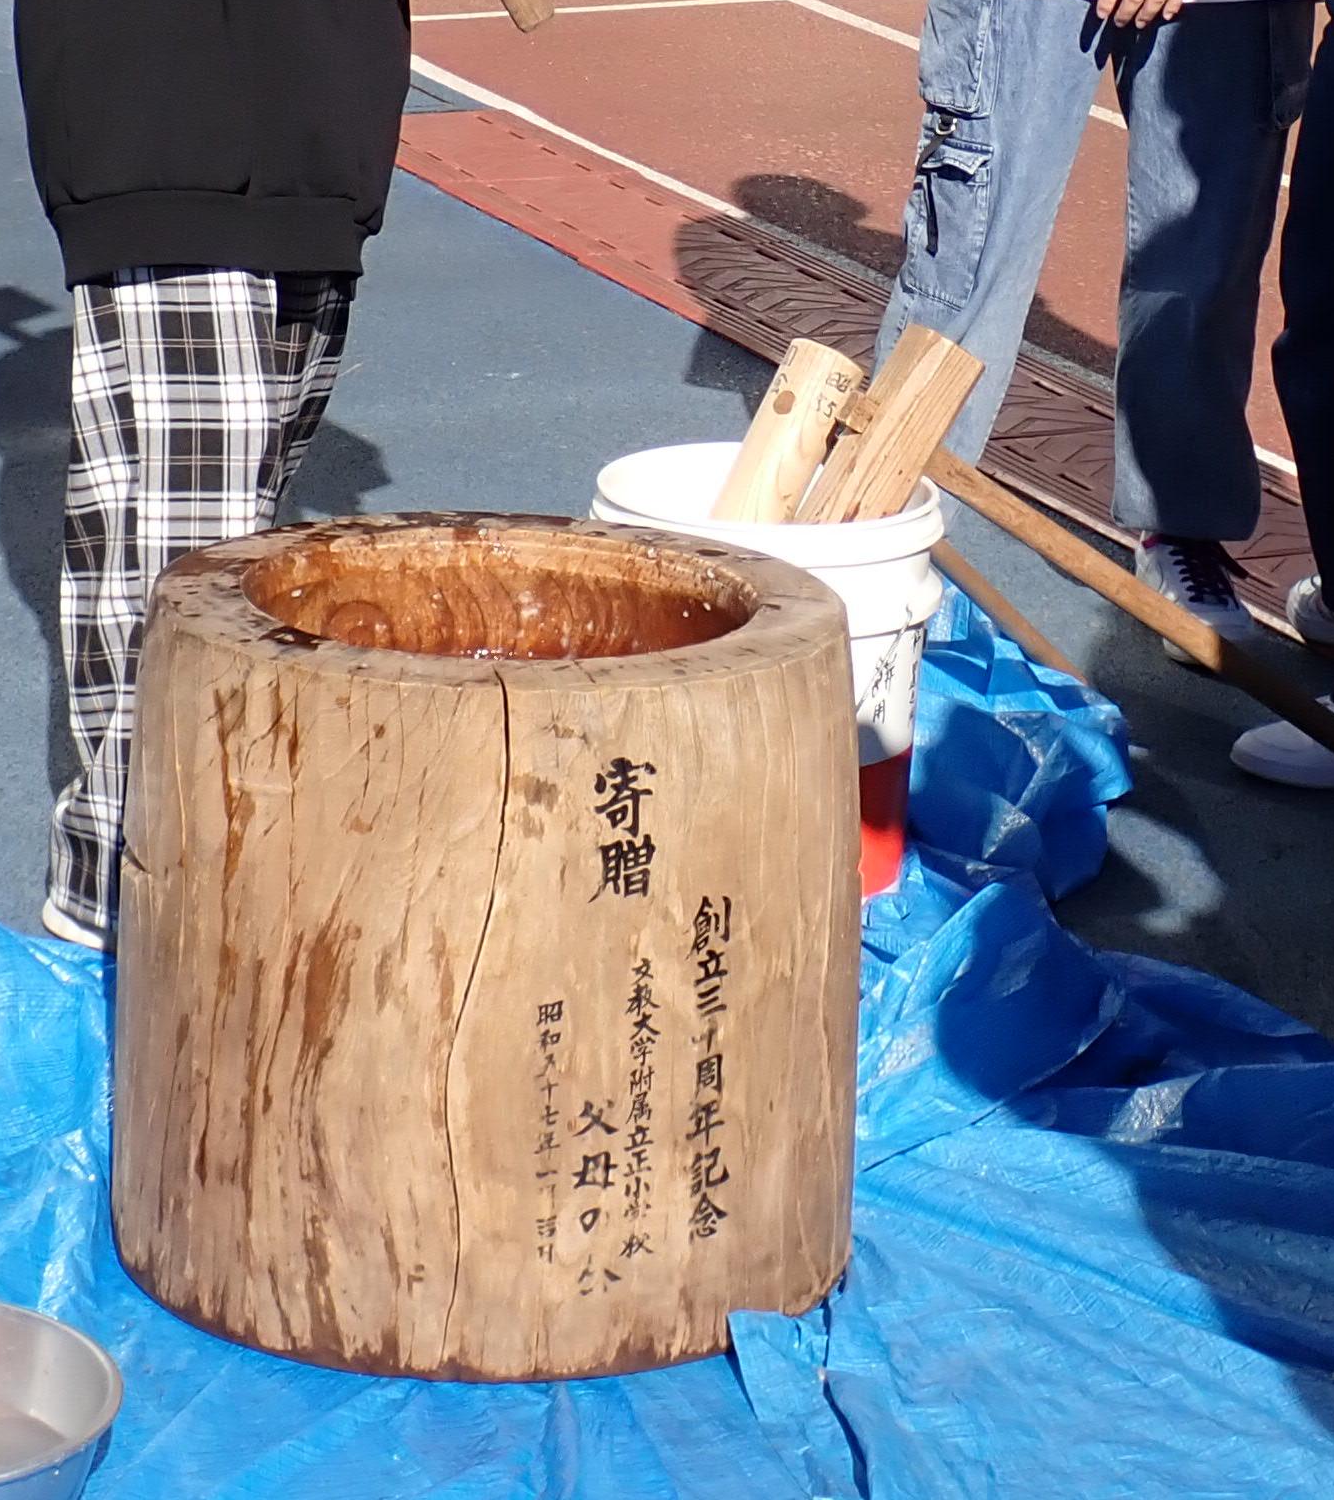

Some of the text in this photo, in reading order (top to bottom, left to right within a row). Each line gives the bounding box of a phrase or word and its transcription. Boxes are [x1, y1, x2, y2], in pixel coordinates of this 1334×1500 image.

[588, 756, 656, 903] 寄贈
[685, 895, 733, 1240] 創立三十周年記念
